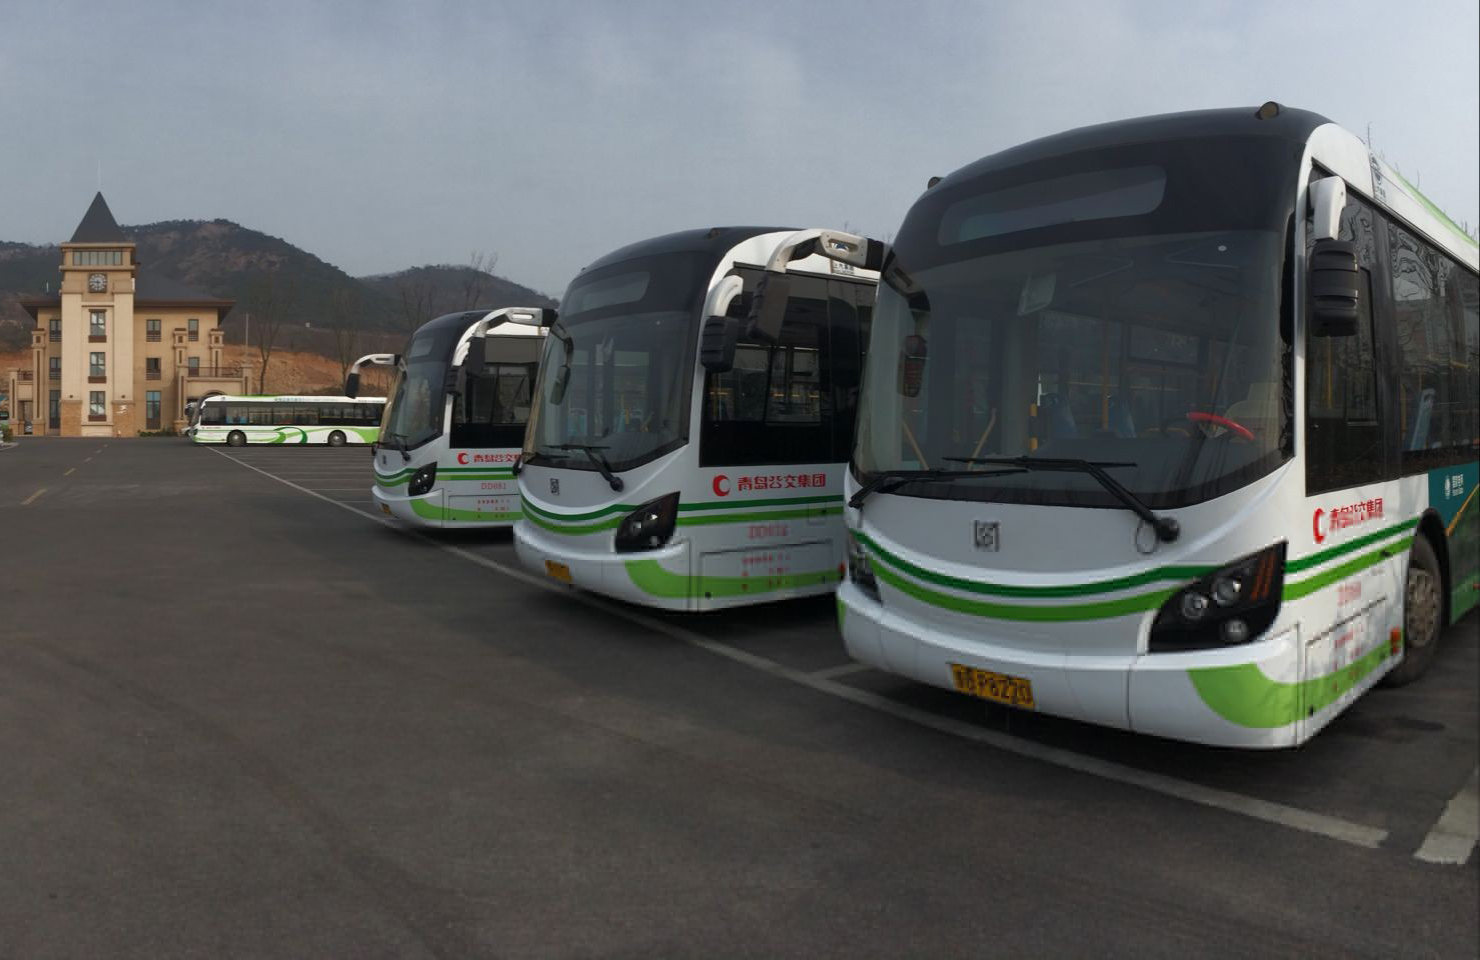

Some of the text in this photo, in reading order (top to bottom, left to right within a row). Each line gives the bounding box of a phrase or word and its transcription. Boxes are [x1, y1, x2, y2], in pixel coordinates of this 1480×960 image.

[738, 473, 826, 491] 青岛公交集团
